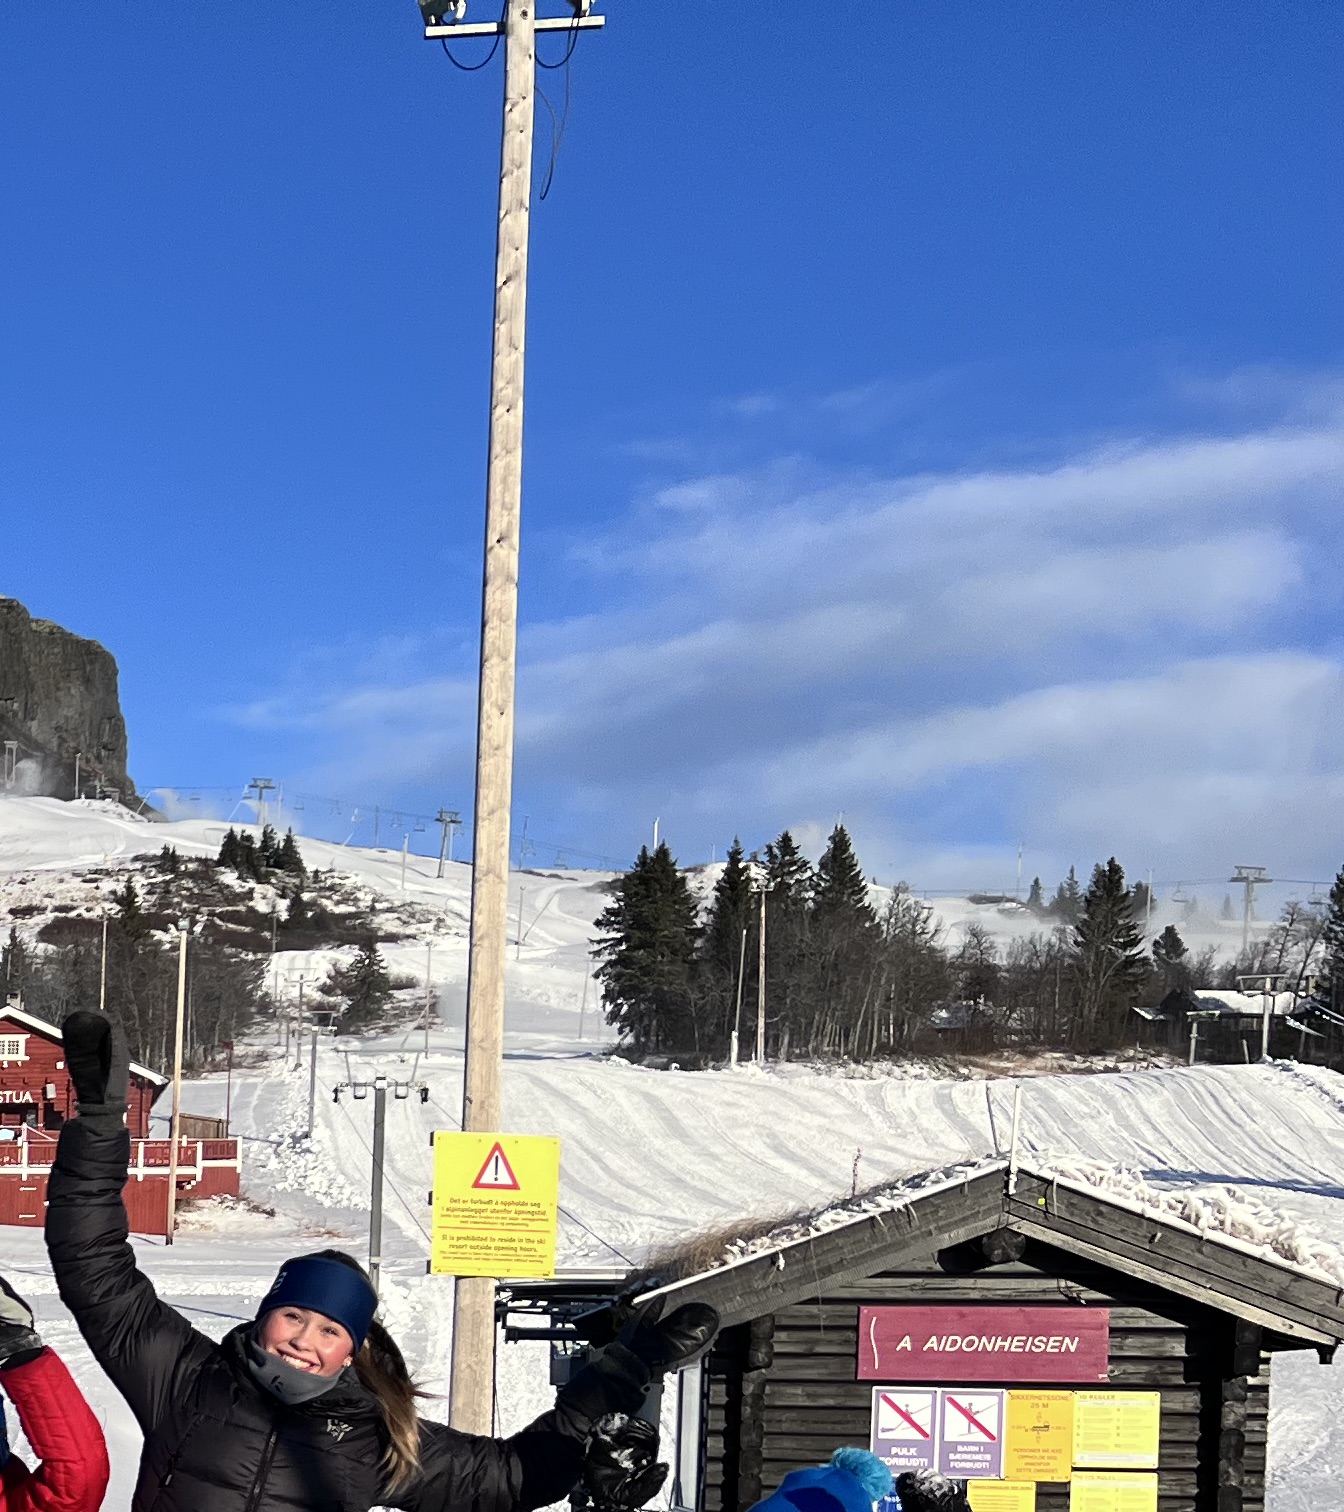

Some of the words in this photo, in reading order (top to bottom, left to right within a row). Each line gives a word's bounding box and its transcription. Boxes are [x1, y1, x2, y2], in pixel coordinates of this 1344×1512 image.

[895, 1335, 912, 1351] A
[922, 1335, 1080, 1353] AIDONHEISEN
[890, 1446, 918, 1456] PULK
